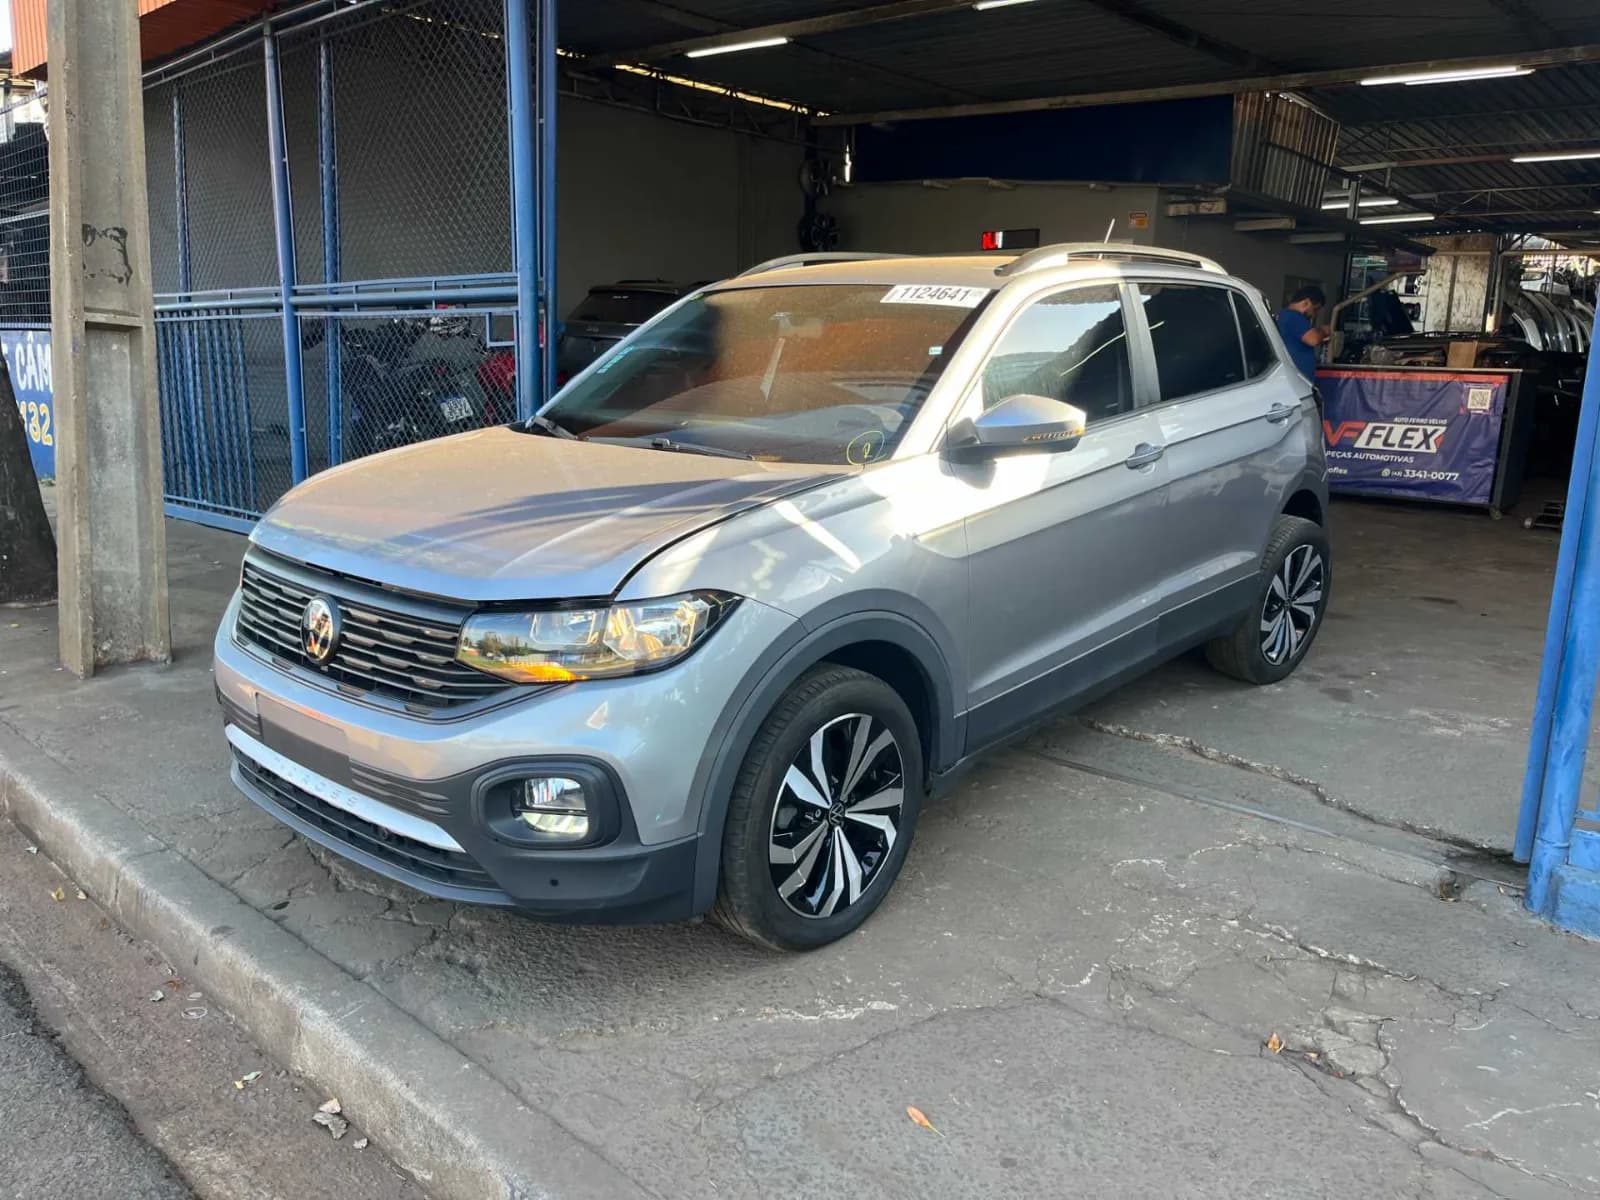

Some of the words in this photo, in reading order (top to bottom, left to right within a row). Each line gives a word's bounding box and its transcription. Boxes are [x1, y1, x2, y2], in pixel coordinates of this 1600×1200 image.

[899, 286, 970, 302] 1124641
[1365, 425, 1439, 450] FLEX
[1325, 450, 1352, 459] PEÇAS
[1353, 453, 1415, 464] AUTOMOTIVAS
[1403, 469, 1460, 481] 3341-0077
